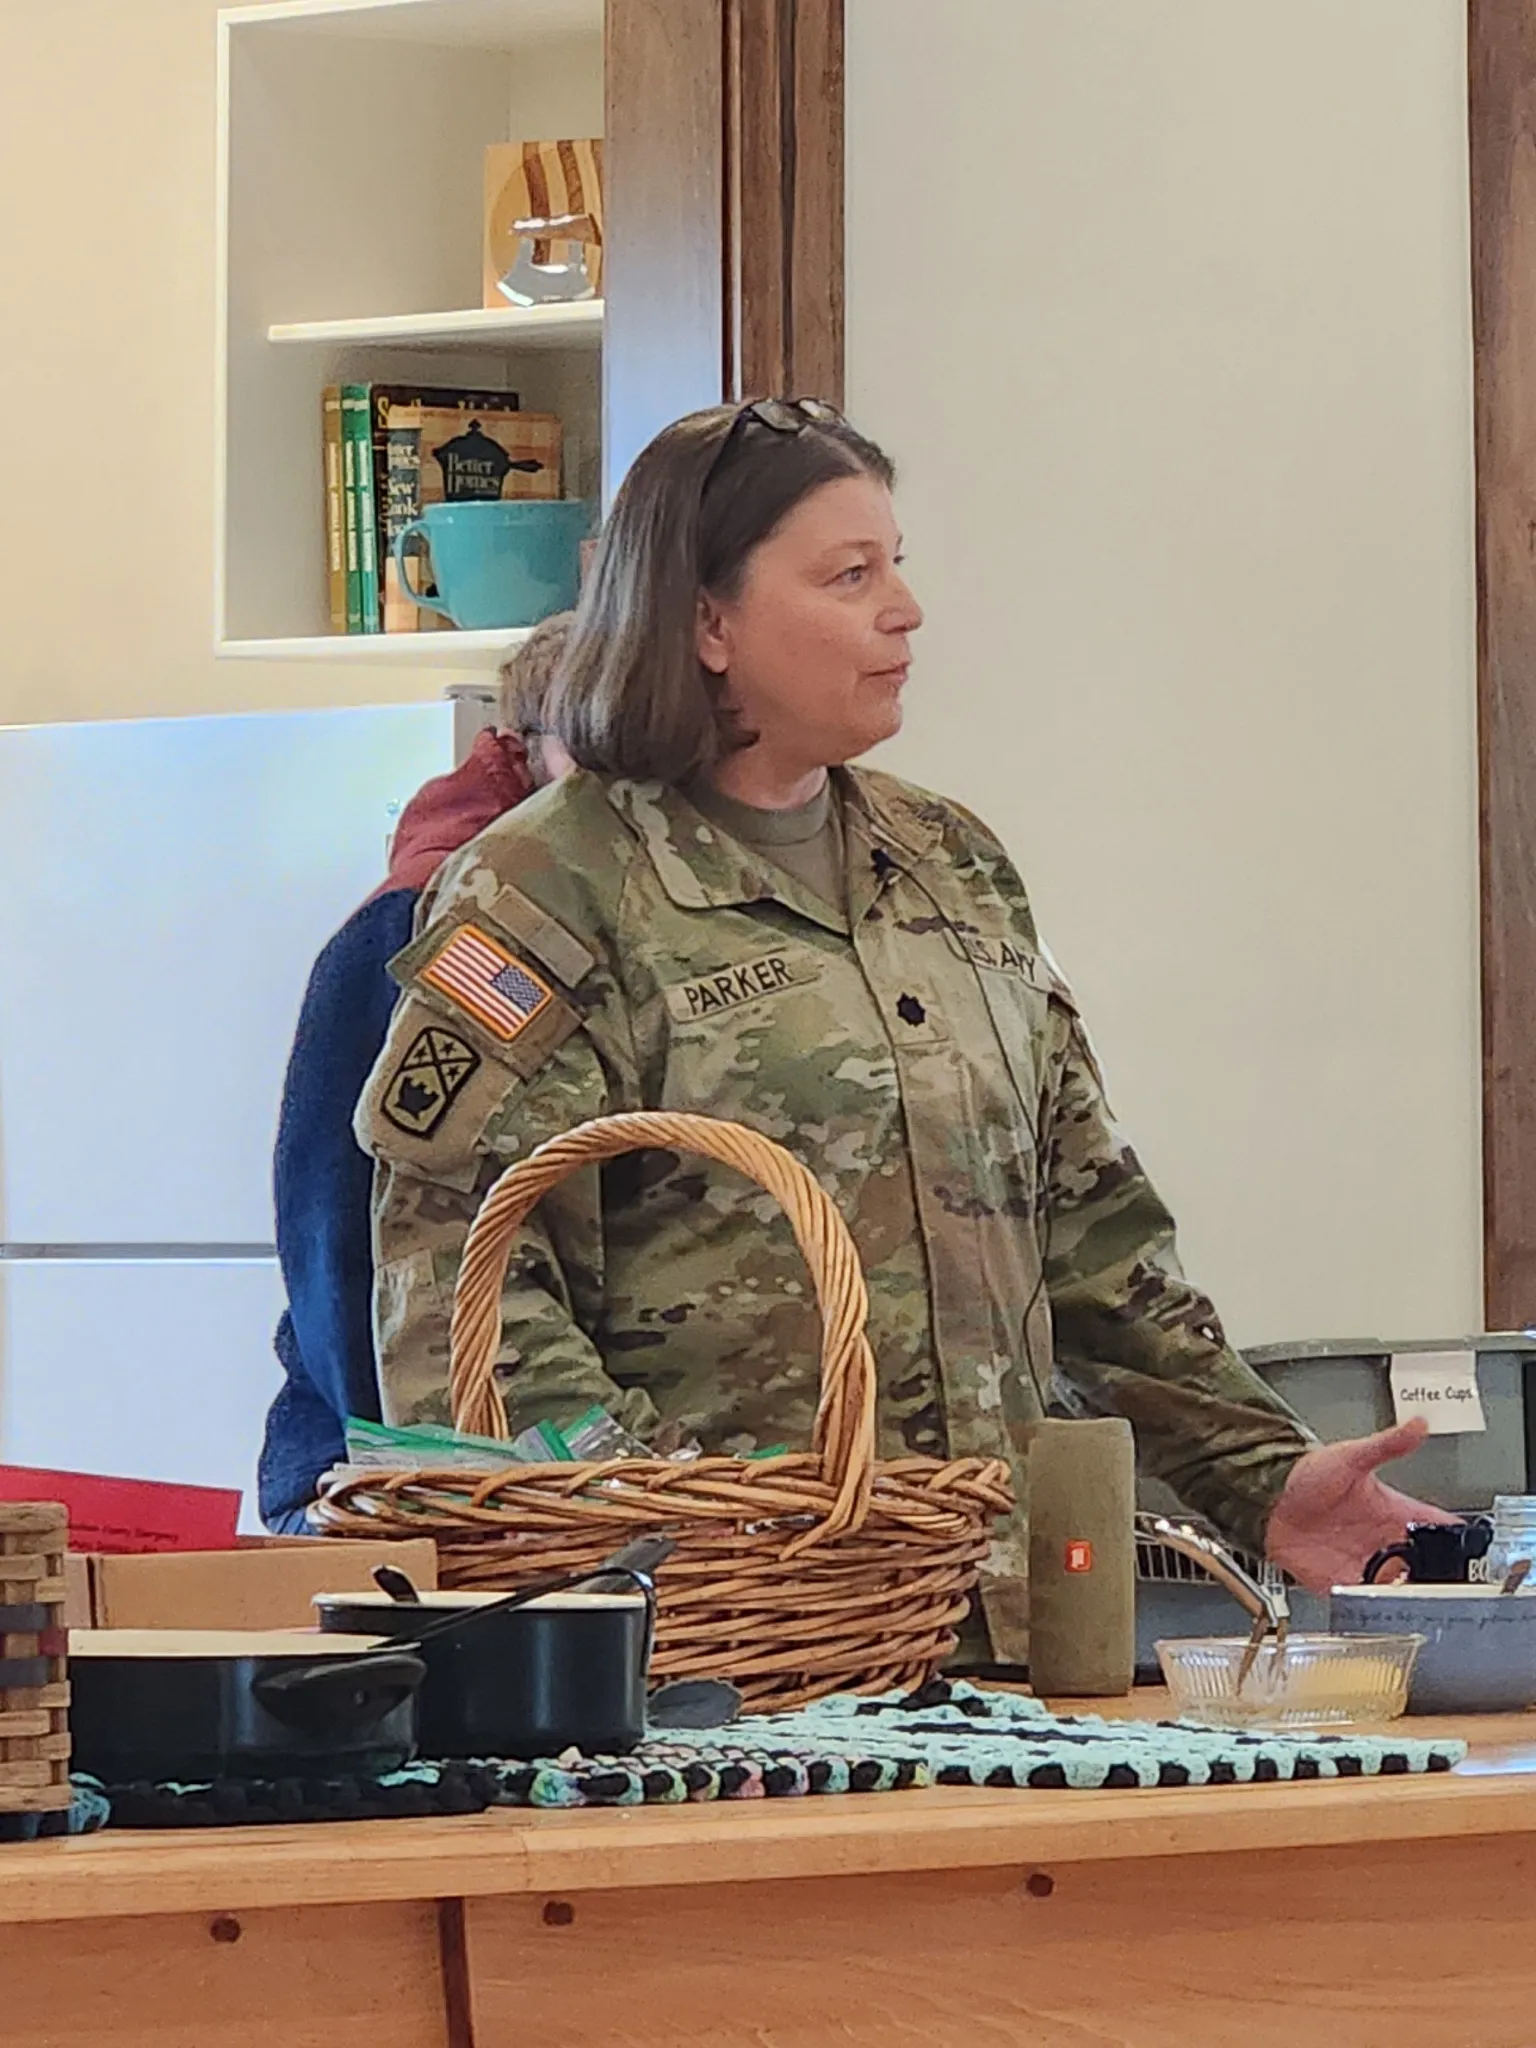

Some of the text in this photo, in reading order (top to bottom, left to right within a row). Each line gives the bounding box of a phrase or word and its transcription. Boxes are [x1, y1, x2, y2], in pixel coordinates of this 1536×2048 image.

[447, 452, 495, 475] Better
[683, 957, 794, 1015] PARKER
[1400, 1386, 1474, 1403] Coffee Cups
